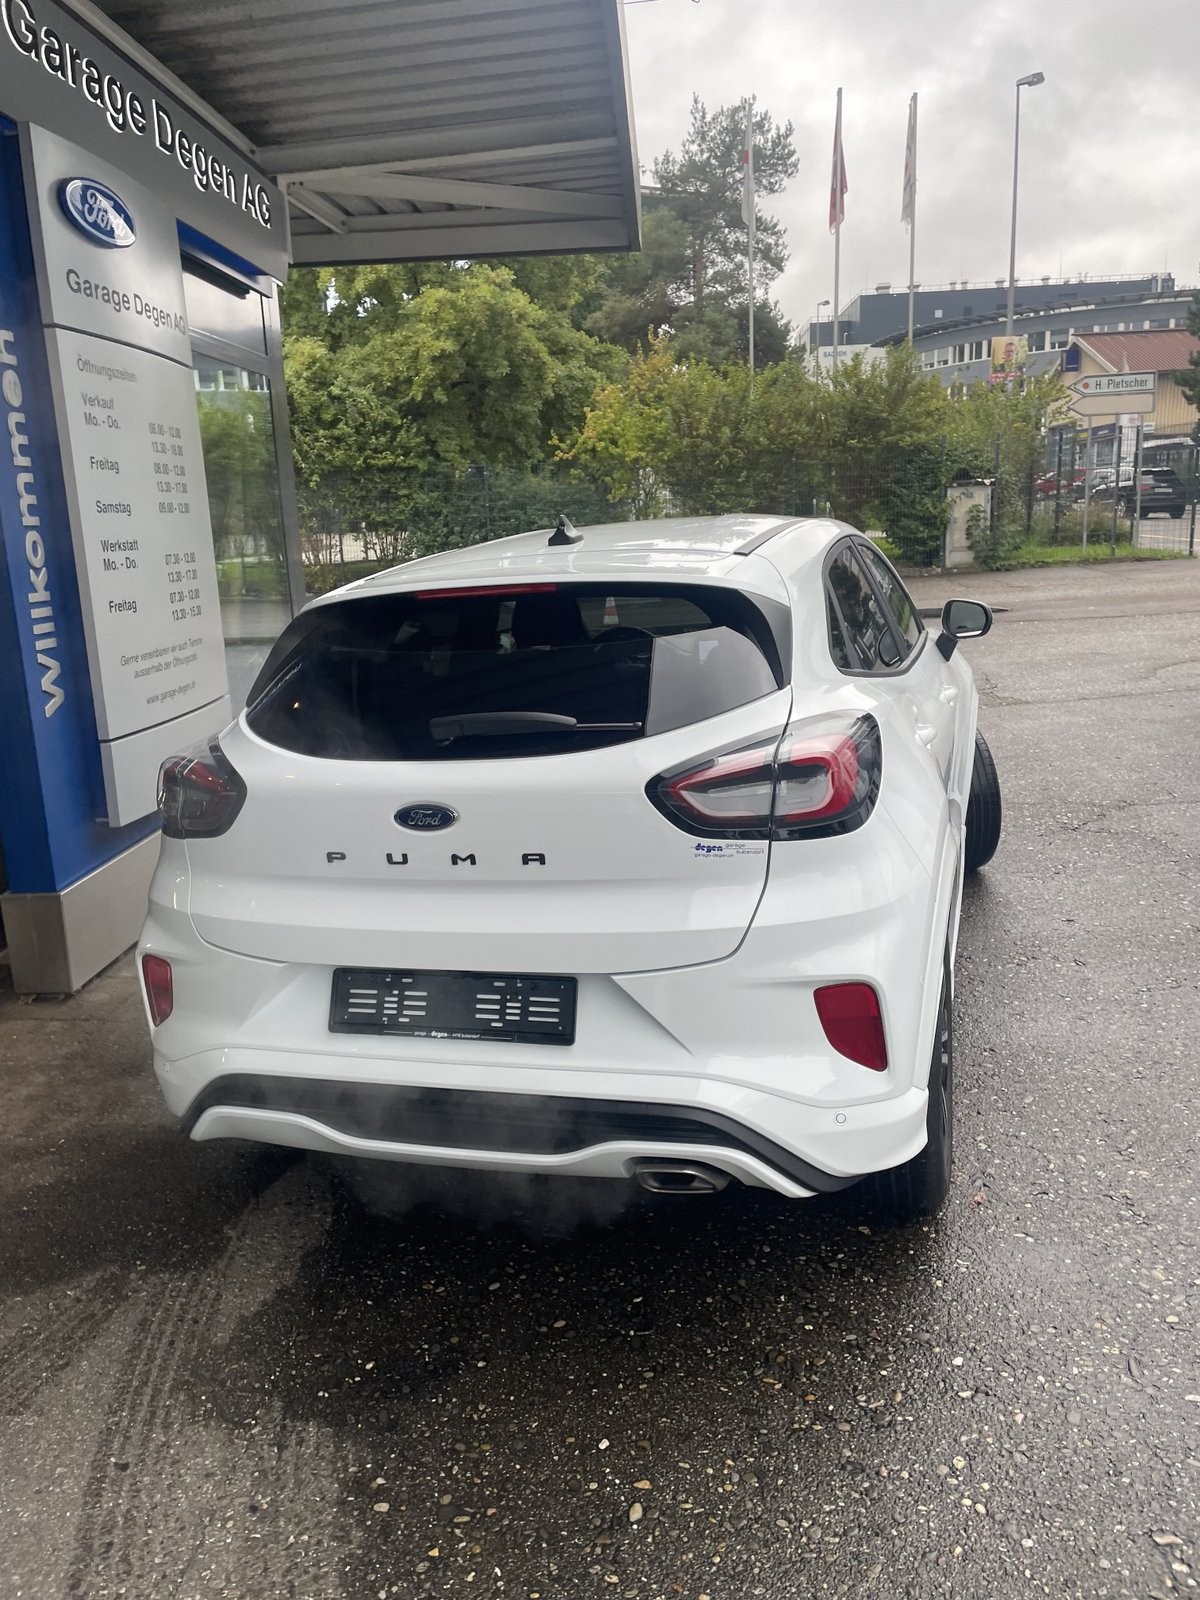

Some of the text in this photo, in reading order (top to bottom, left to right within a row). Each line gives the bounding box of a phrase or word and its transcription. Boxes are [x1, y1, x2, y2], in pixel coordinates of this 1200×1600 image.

[1, 0, 272, 229] Garage Degen AG
[84, 188, 126, 238] Ford
[66, 268, 186, 335] Garage Degen AG
[1107, 378, 1148, 390] Pletscher
[81, 392, 115, 410] Verkauf
[84, 412, 101, 427] Mo.
[107, 415, 121, 429] Do.
[90, 456, 120, 474] Freitag
[96, 500, 131, 516] Samstag
[100, 539, 139, 553] Werkstatt
[103, 557, 119, 571] Mo.
[125, 556, 138, 569] Do.
[167, 570, 182, 583] 13.30
[109, 600, 138, 614] Freitag
[120, 655, 140, 666] Gerne
[408, 809, 442, 826] Ford
[695, 842, 723, 853] degen
[326, 851, 546, 866] PUMA
